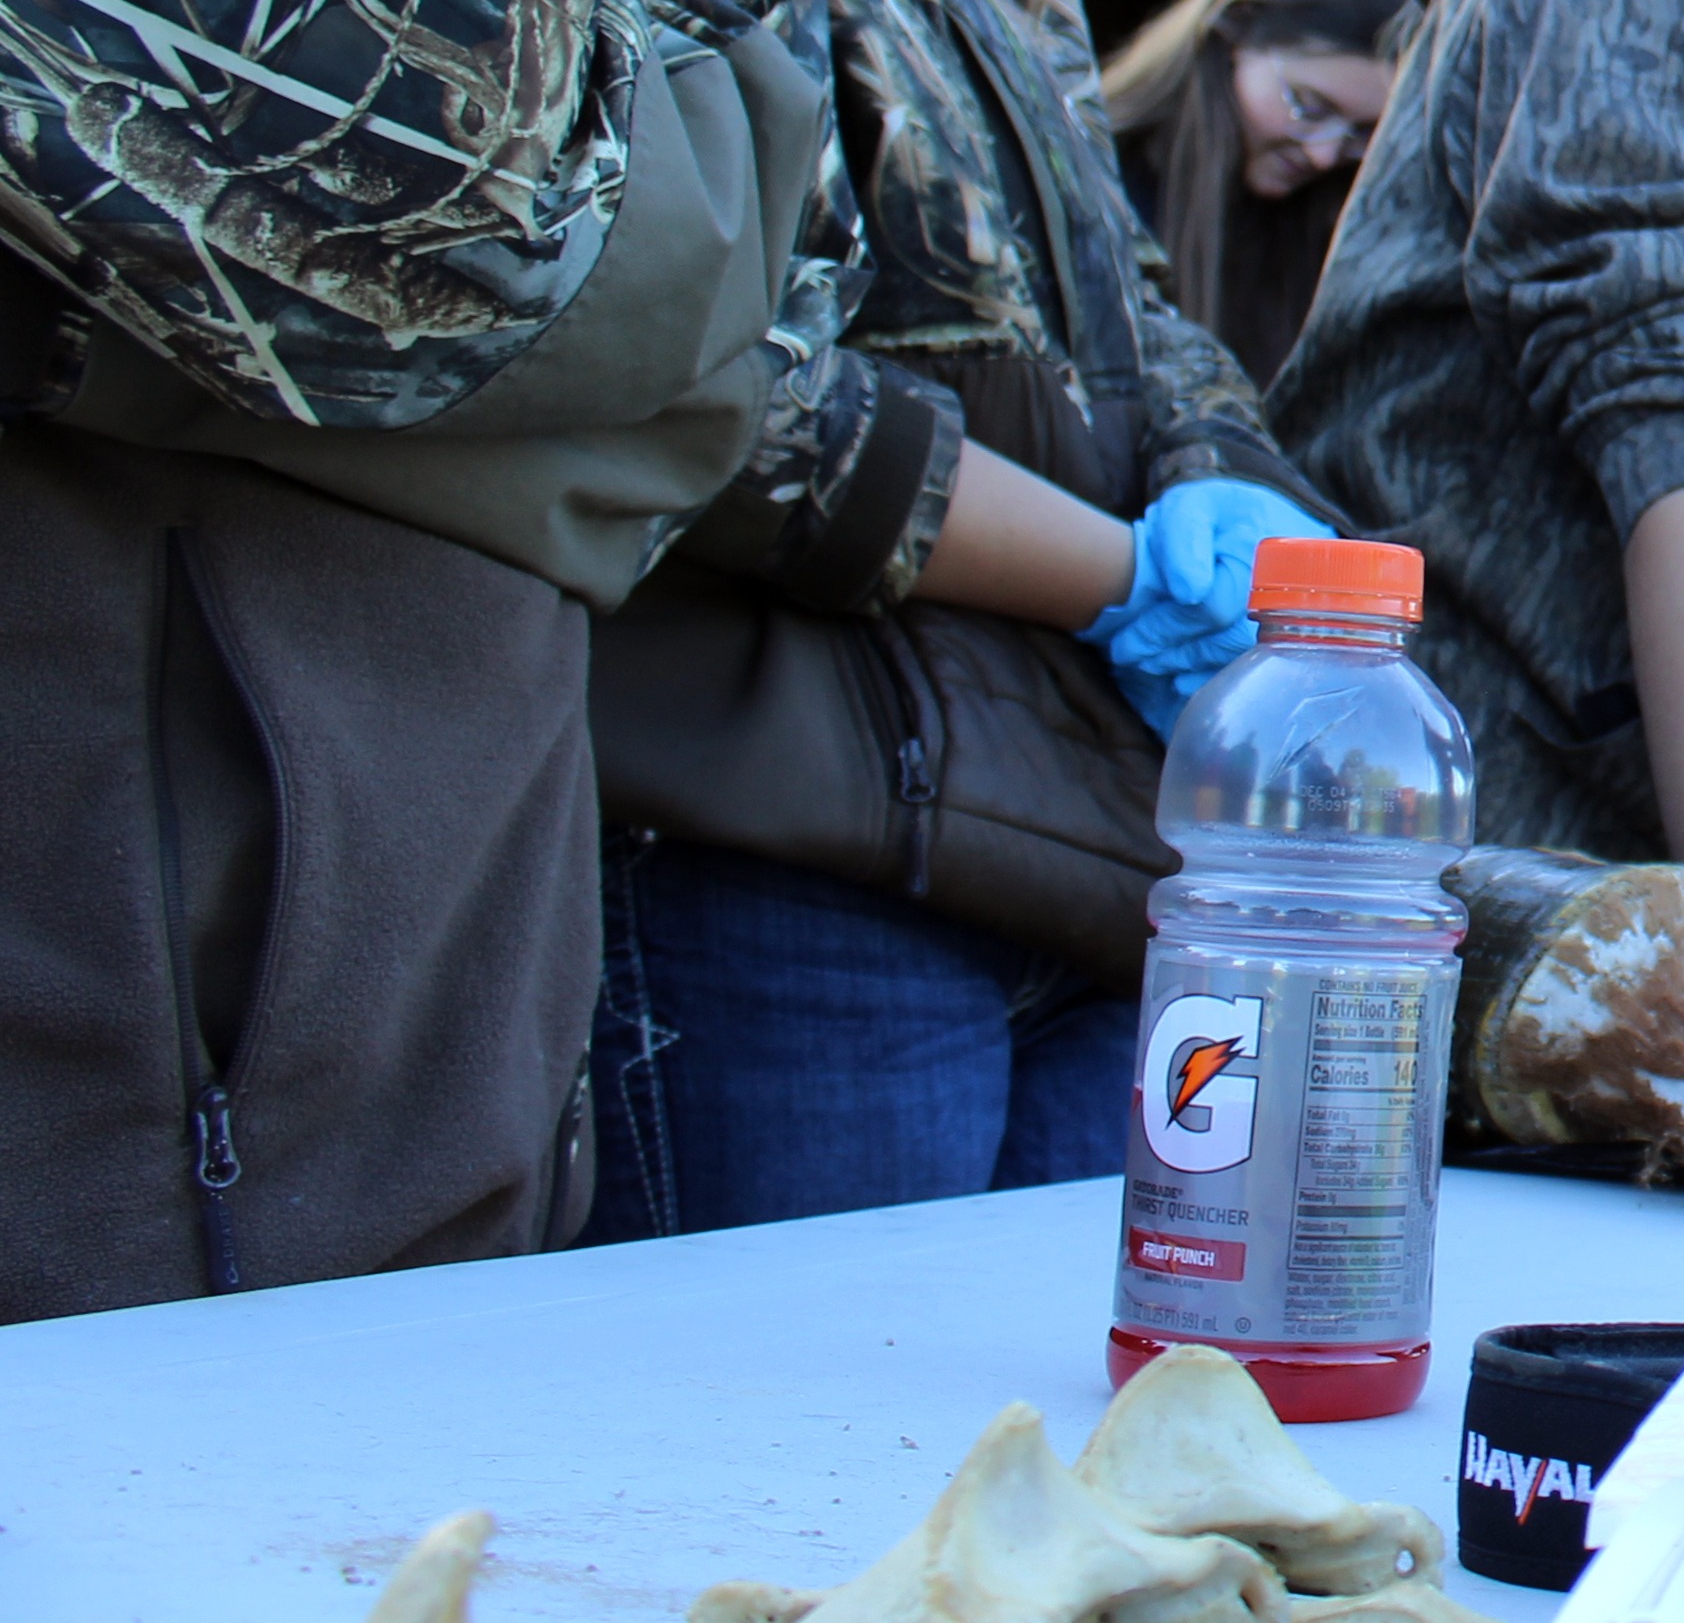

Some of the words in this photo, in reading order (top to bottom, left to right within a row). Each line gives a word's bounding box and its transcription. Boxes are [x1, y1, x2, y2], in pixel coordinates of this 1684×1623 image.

[1317, 996, 1386, 1018] Nutrition
[1390, 999, 1424, 1020] Facts
[1314, 1023, 1342, 1039] Serving
[1142, 993, 1263, 1174] G
[1310, 1063, 1370, 1086] Calories
[1393, 1060, 1418, 1086] 140
[1131, 1192, 1167, 1215] THIRST
[1167, 1201, 1250, 1227] QUENCHER
[1142, 1240, 1172, 1262] FRUIT
[1173, 1246, 1217, 1268] PUNCH
[1181, 1312, 1199, 1331] 591
